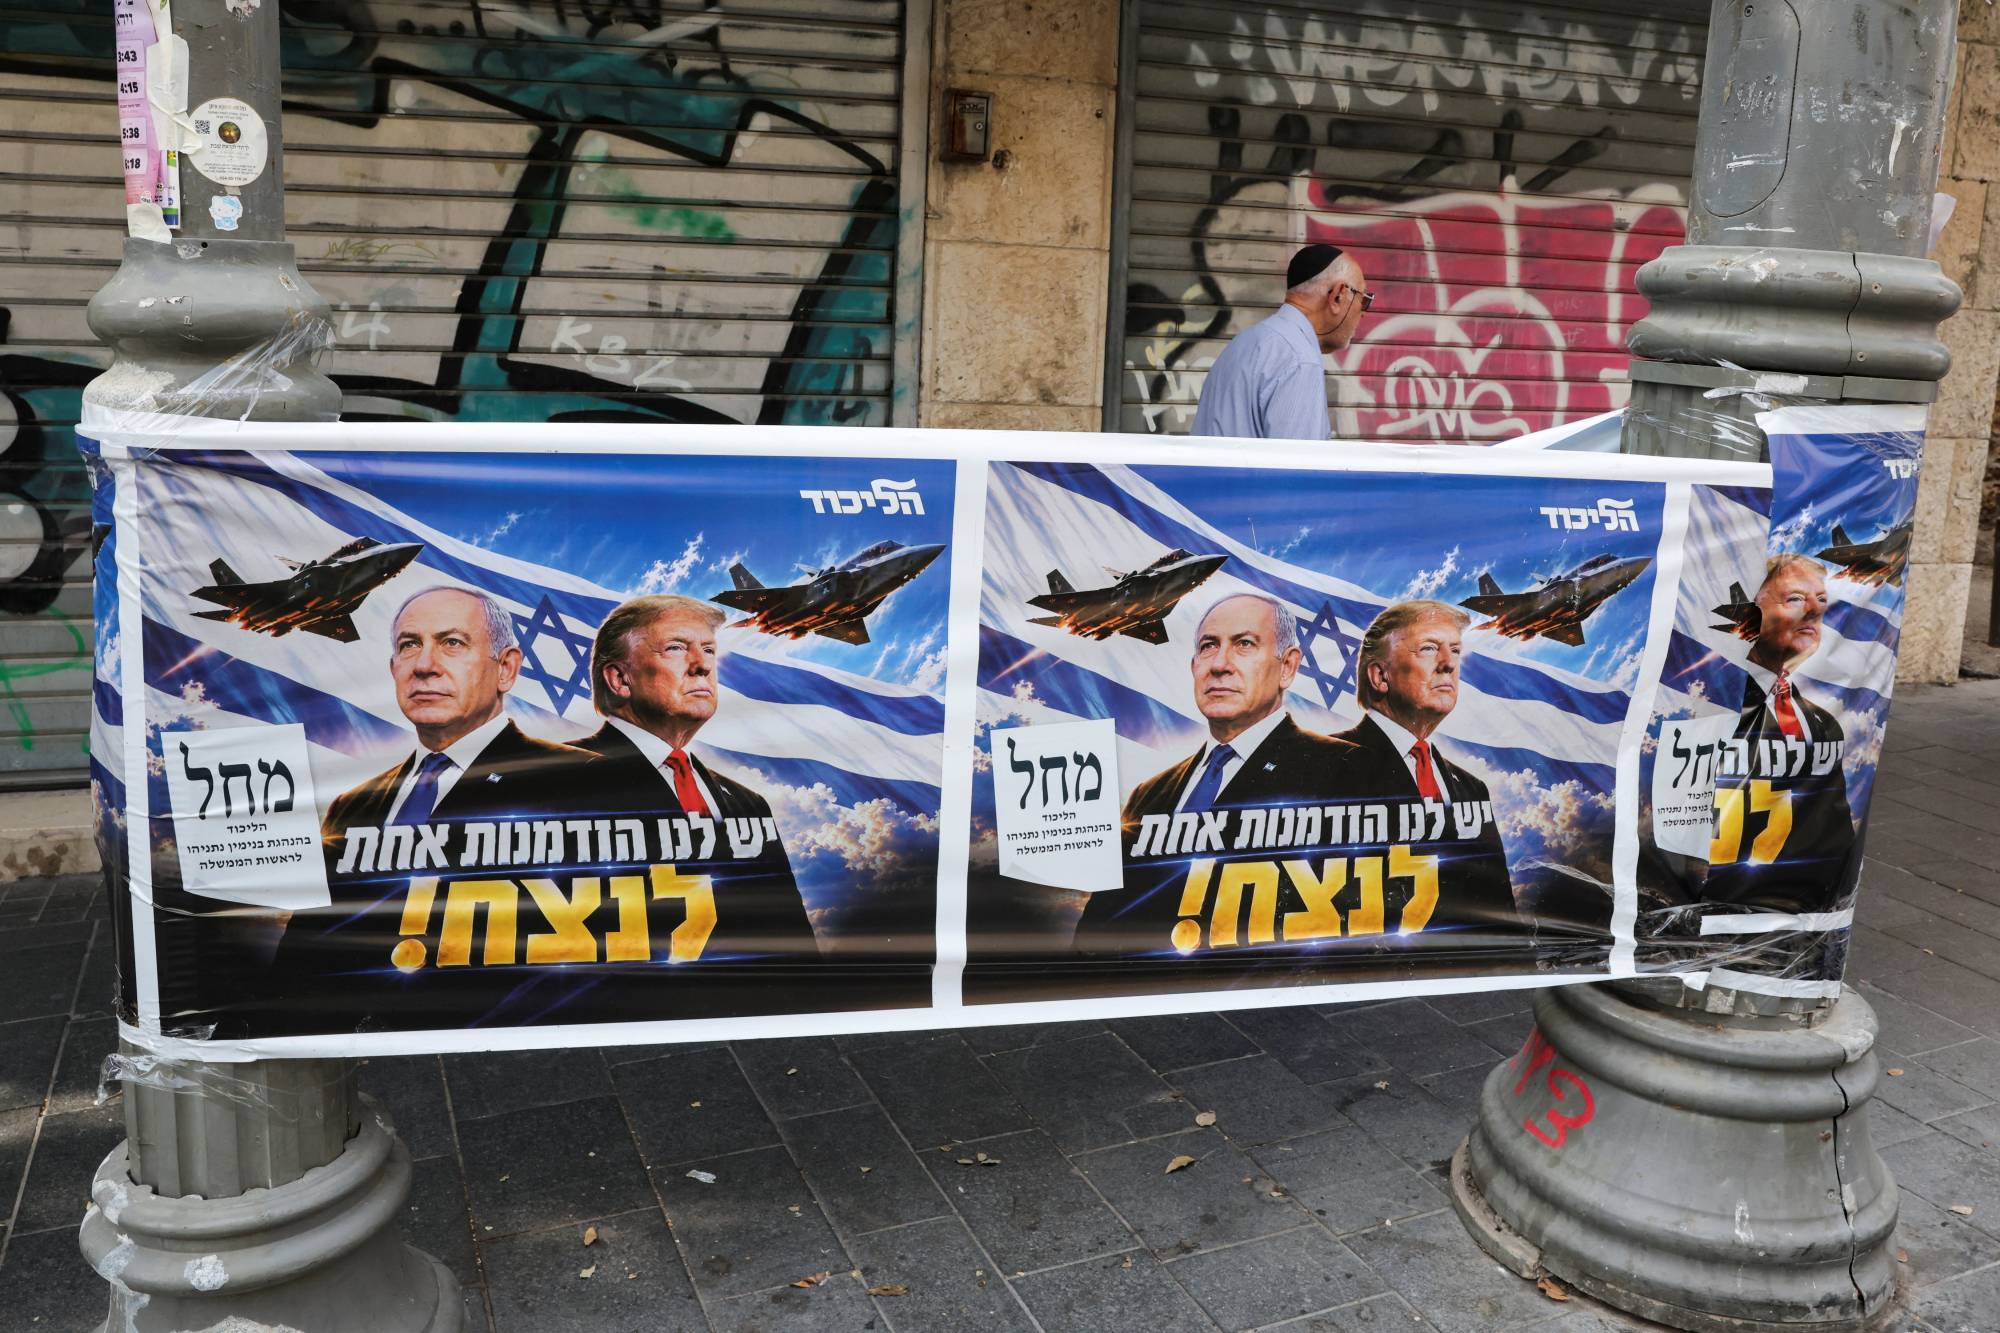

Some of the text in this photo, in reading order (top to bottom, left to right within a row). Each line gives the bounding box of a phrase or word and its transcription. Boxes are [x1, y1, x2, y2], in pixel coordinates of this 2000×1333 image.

[121, 82, 138, 93] 4:15
[123, 127, 140, 139] 5:38
[800, 478, 925, 515] הליכוד
[1540, 498, 1640, 532] הליכוד
[1759, 734, 1806, 777] לנו
[1811, 740, 1844, 775] יש
[179, 741, 295, 820] מחל
[1007, 737, 1102, 809] מחל
[227, 822, 267, 834] הליכוד
[1006, 823, 1112, 841] בהנהגת בנימין נתניהו
[1042, 811, 1076, 822] הליכוד
[1131, 797, 1493, 857] יש לנו הזדמנות אחת
[187, 836, 311, 855] בהנהגת בנימין נתניהו
[336, 811, 778, 874] יש לנו הזדמנות אחת
[1016, 838, 1103, 856] לראשות הממשלה
[200, 852, 302, 870] לראשות הממשלה
[1171, 844, 1439, 956] לנצח!
[391, 863, 717, 974] לנצח!
